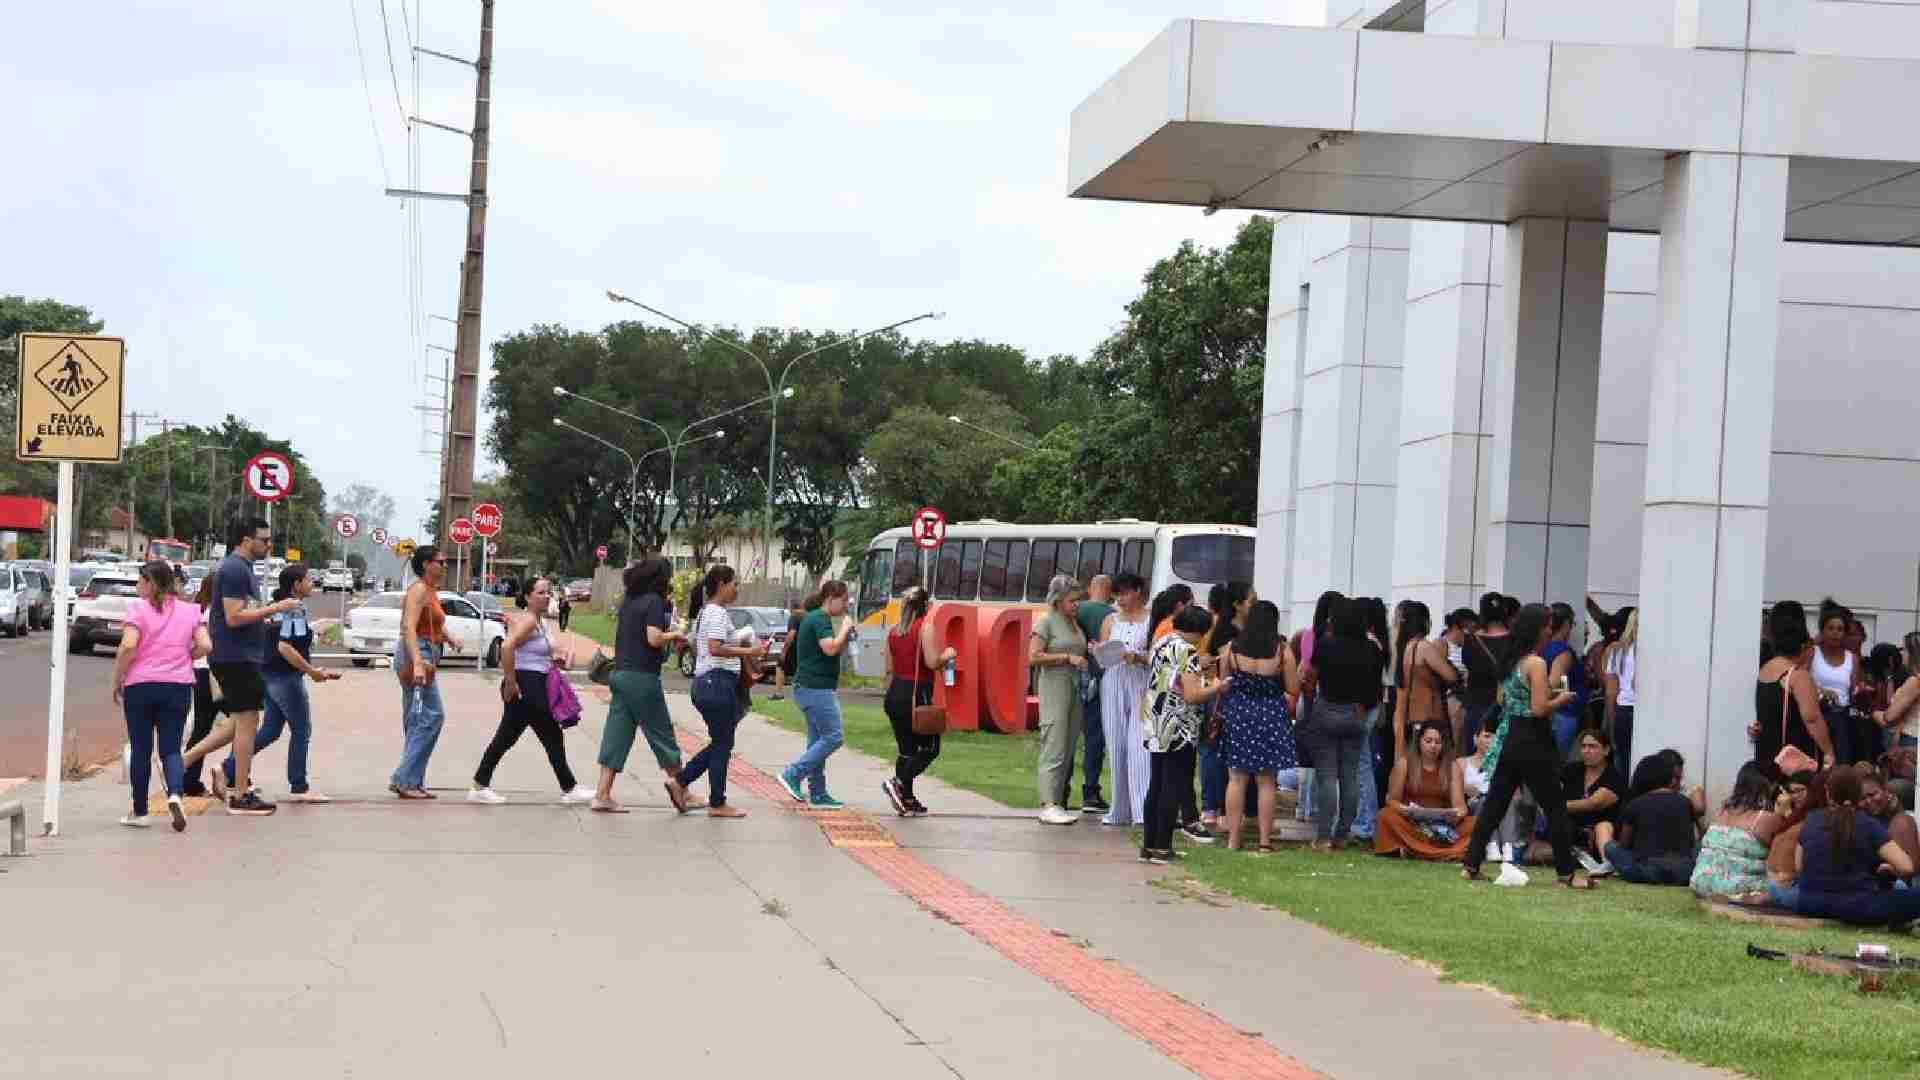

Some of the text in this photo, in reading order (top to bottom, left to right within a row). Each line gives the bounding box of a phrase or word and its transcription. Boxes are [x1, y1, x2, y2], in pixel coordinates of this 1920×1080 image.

[50, 412, 94, 425] FAIXA
[37, 424, 104, 438] ELEVADA
[260, 463, 280, 490] E
[475, 512, 500, 529] PARE
[451, 527, 473, 538] PARE
